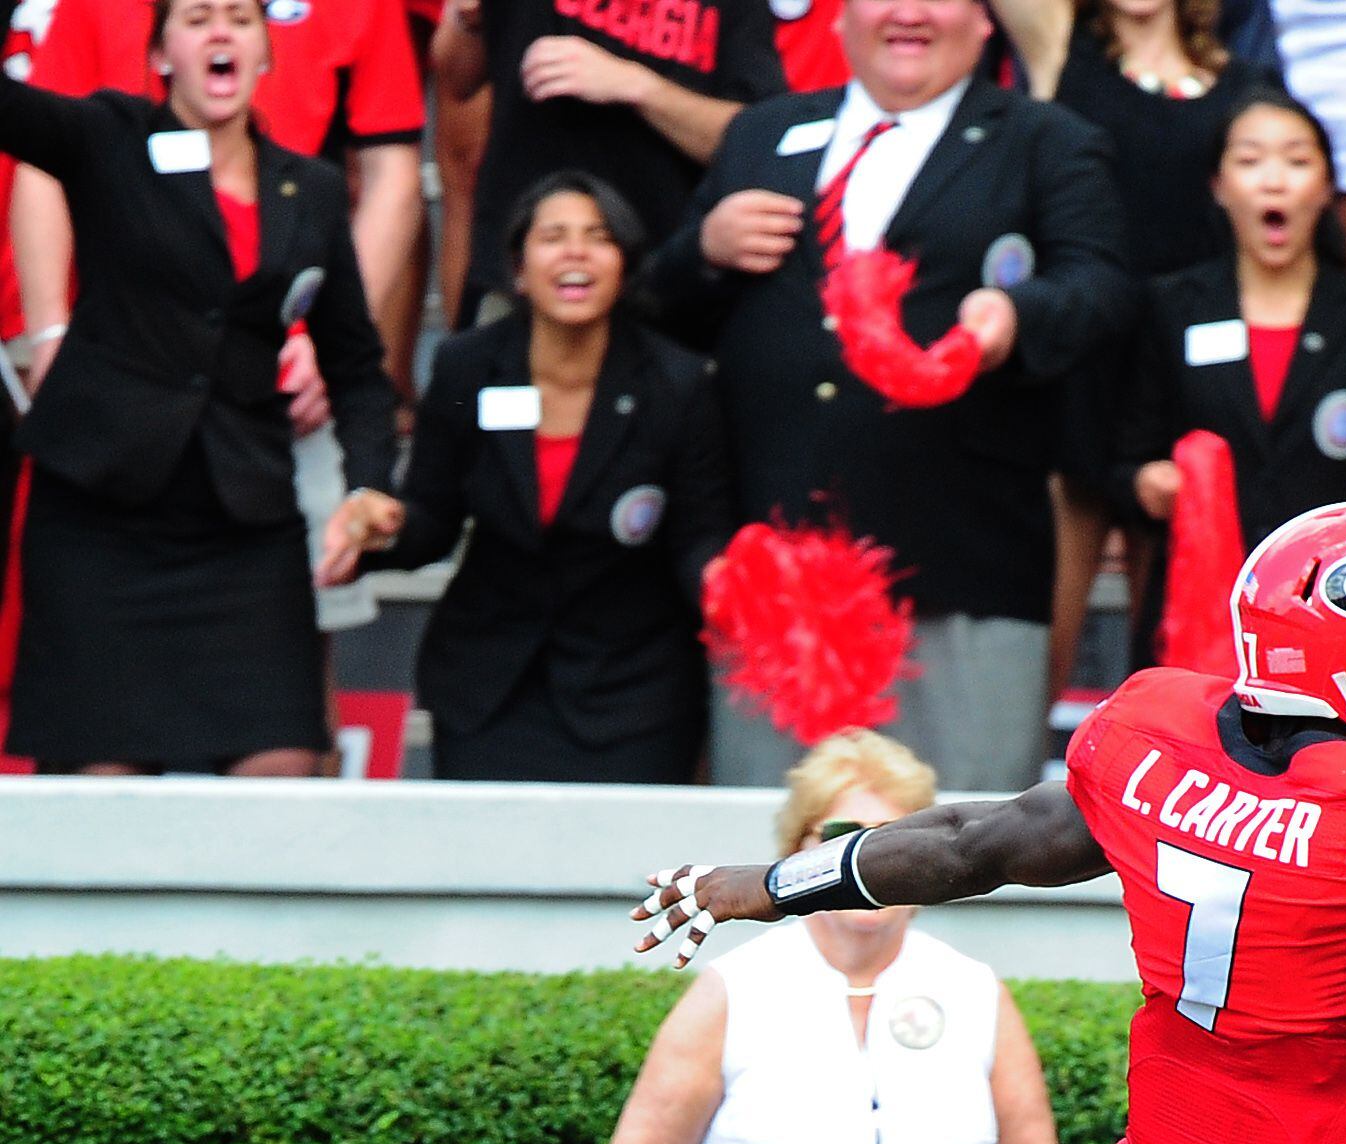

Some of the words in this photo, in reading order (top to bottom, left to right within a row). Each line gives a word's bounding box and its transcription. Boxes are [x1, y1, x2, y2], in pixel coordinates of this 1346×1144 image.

[1121, 749, 1162, 816] L.
[1159, 769, 1322, 868] CARTER
[1156, 838, 1254, 1032] 7
